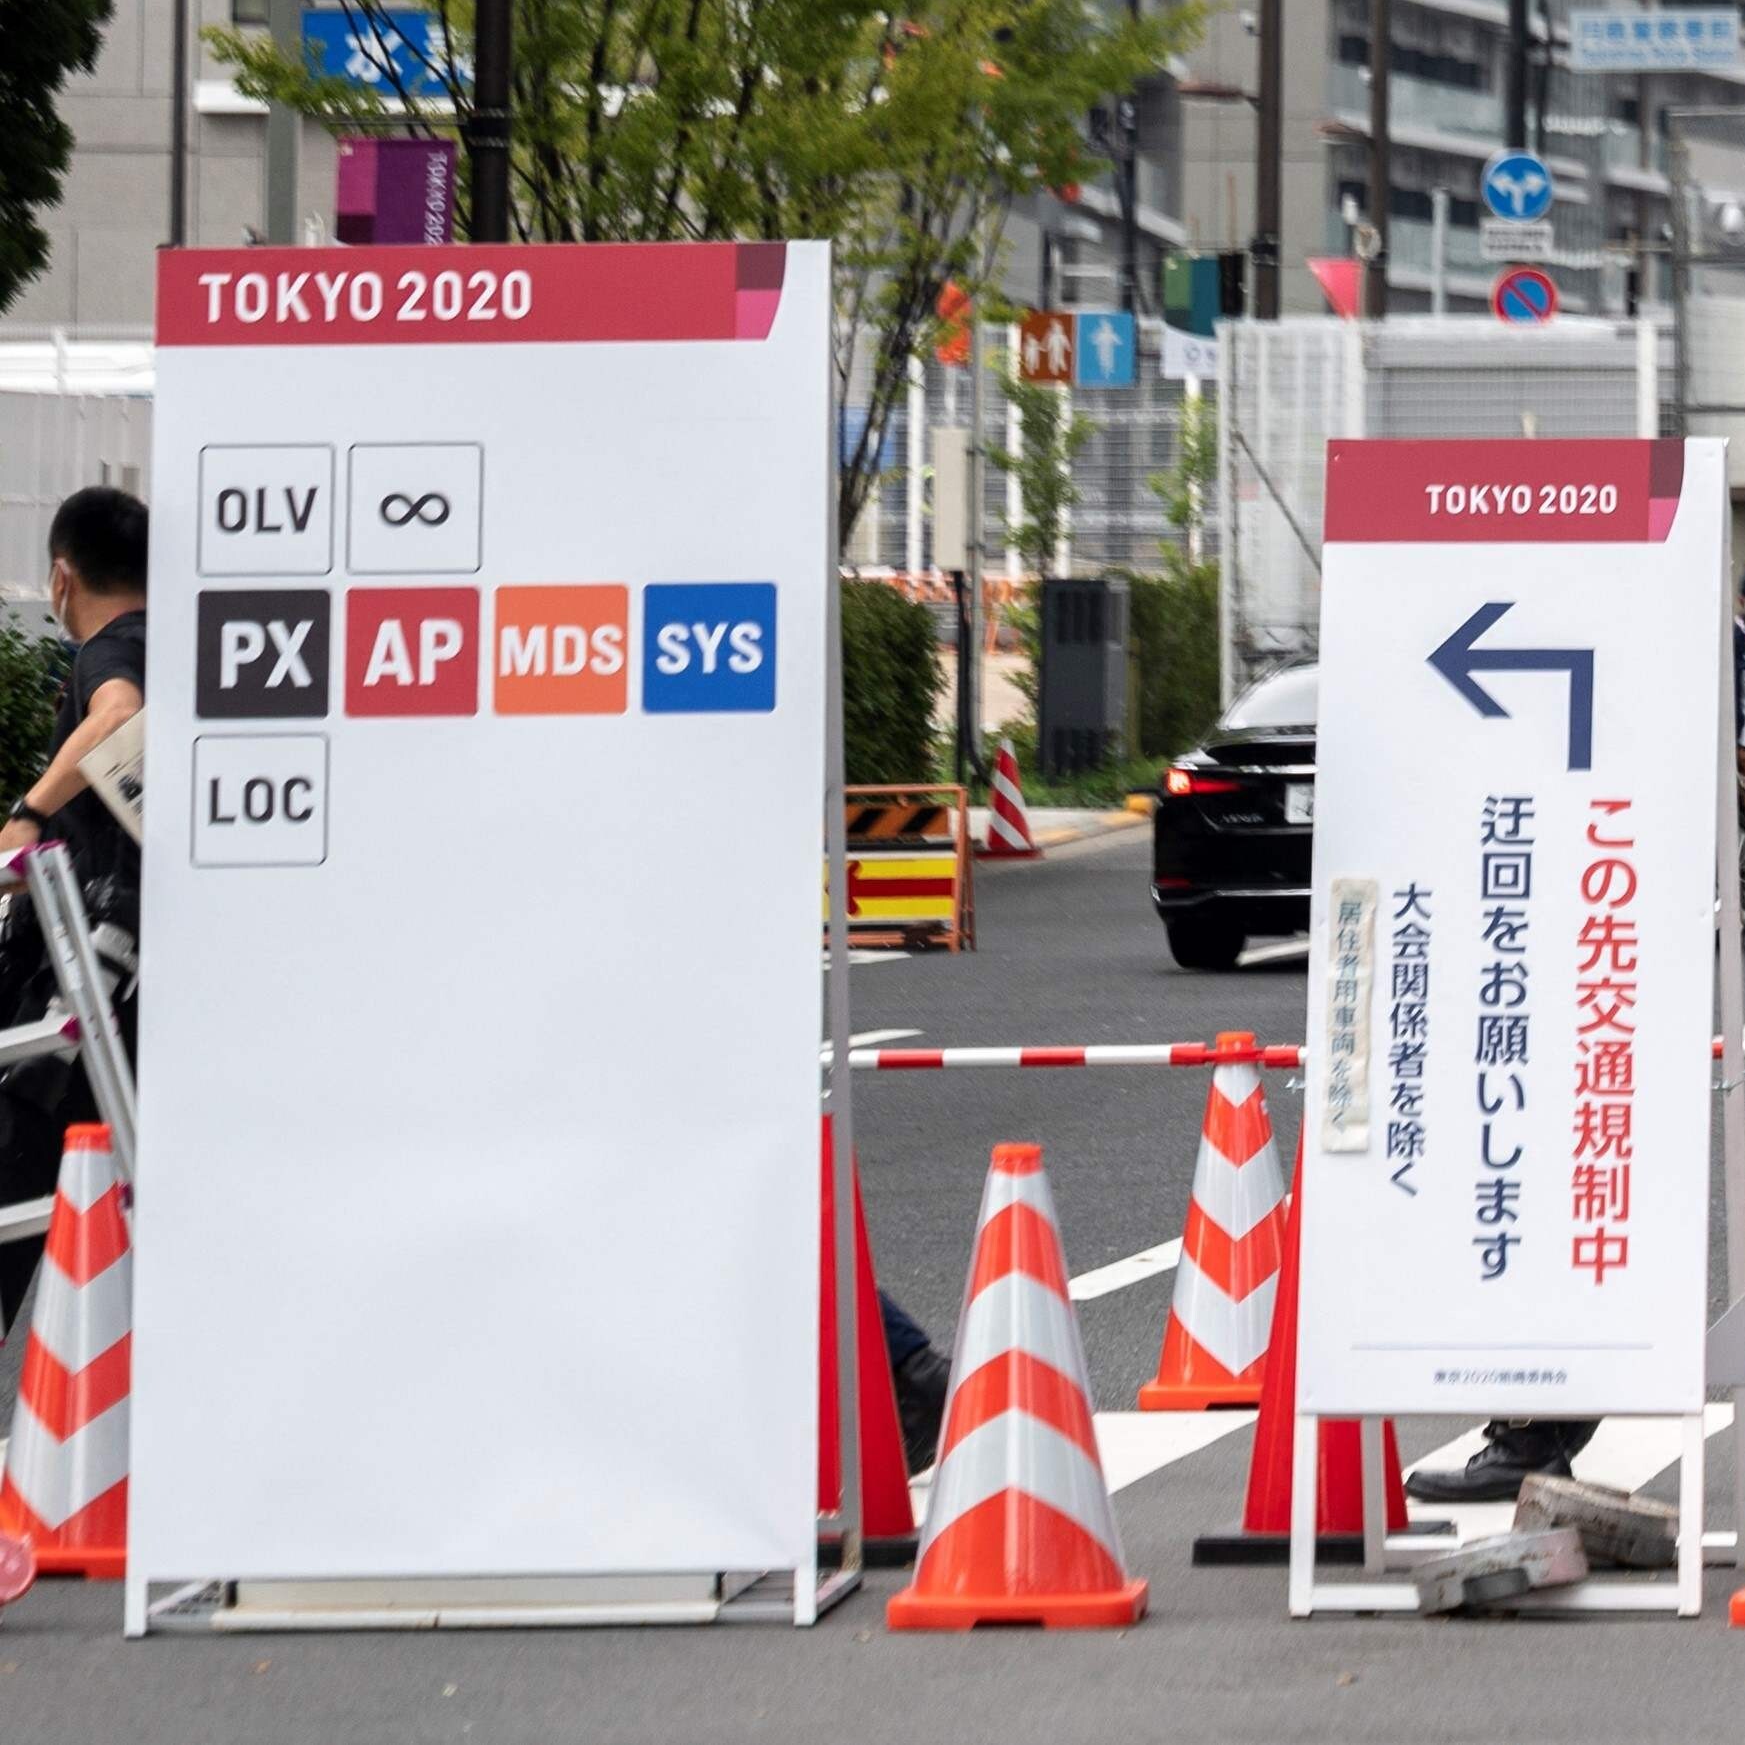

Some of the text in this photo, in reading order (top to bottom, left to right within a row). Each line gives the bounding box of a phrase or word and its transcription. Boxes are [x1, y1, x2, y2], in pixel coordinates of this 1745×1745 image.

[199, 269, 534, 325] TOKYO 2020
[215, 486, 319, 535] OLV
[1424, 483, 1620, 517] TOKYO 2020
[218, 617, 766, 691] PX AP MDS SYS
[207, 774, 317, 827] LOC
[1385, 881, 1435, 1199] 大会関係者を除く
[1471, 793, 1537, 1283] 迂回をお願いします
[1568, 796, 1641, 1287] この先交通規制中
